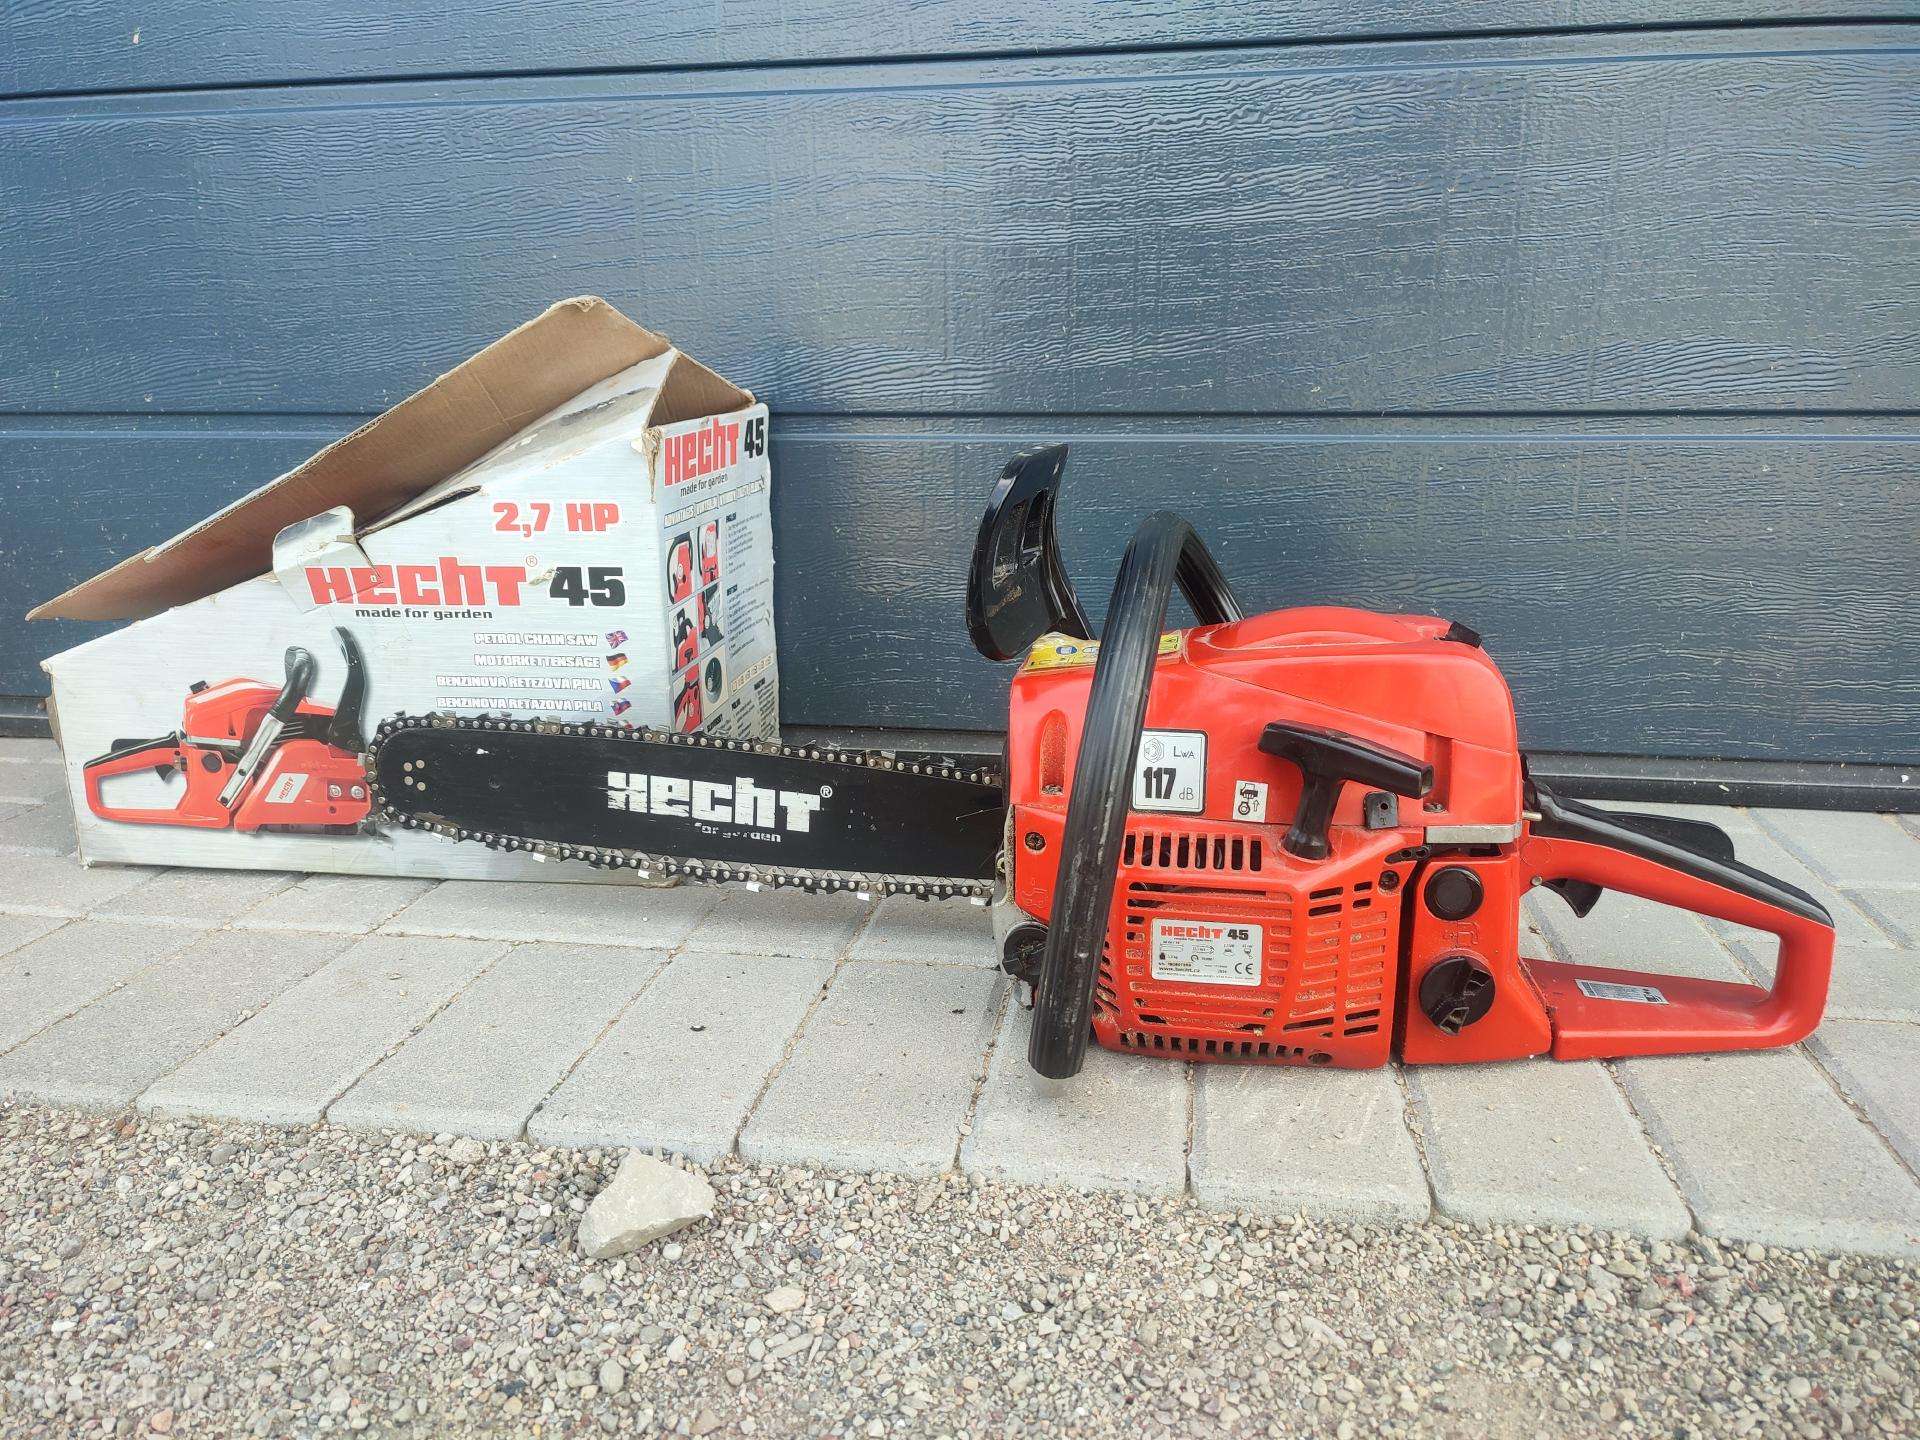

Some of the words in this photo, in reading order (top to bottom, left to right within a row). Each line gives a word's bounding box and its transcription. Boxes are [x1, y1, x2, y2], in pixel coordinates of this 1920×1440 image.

[744, 417, 764, 458] 45
[680, 481, 698, 497] made
[698, 479, 707, 491] for
[708, 473, 728, 489] garden
[493, 502, 551, 538] 2,7
[566, 503, 619, 532] HP
[549, 566, 626, 607] 45
[355, 607, 403, 619] made
[404, 607, 431, 619] for
[434, 609, 493, 620] garden
[474, 632, 523, 645] PETROL
[524, 633, 565, 645] CHAIN
[566, 634, 597, 646] SAW
[1143, 766, 1177, 799] 117
[1179, 786, 1194, 800] dB
[1227, 929, 1249, 941] 45
